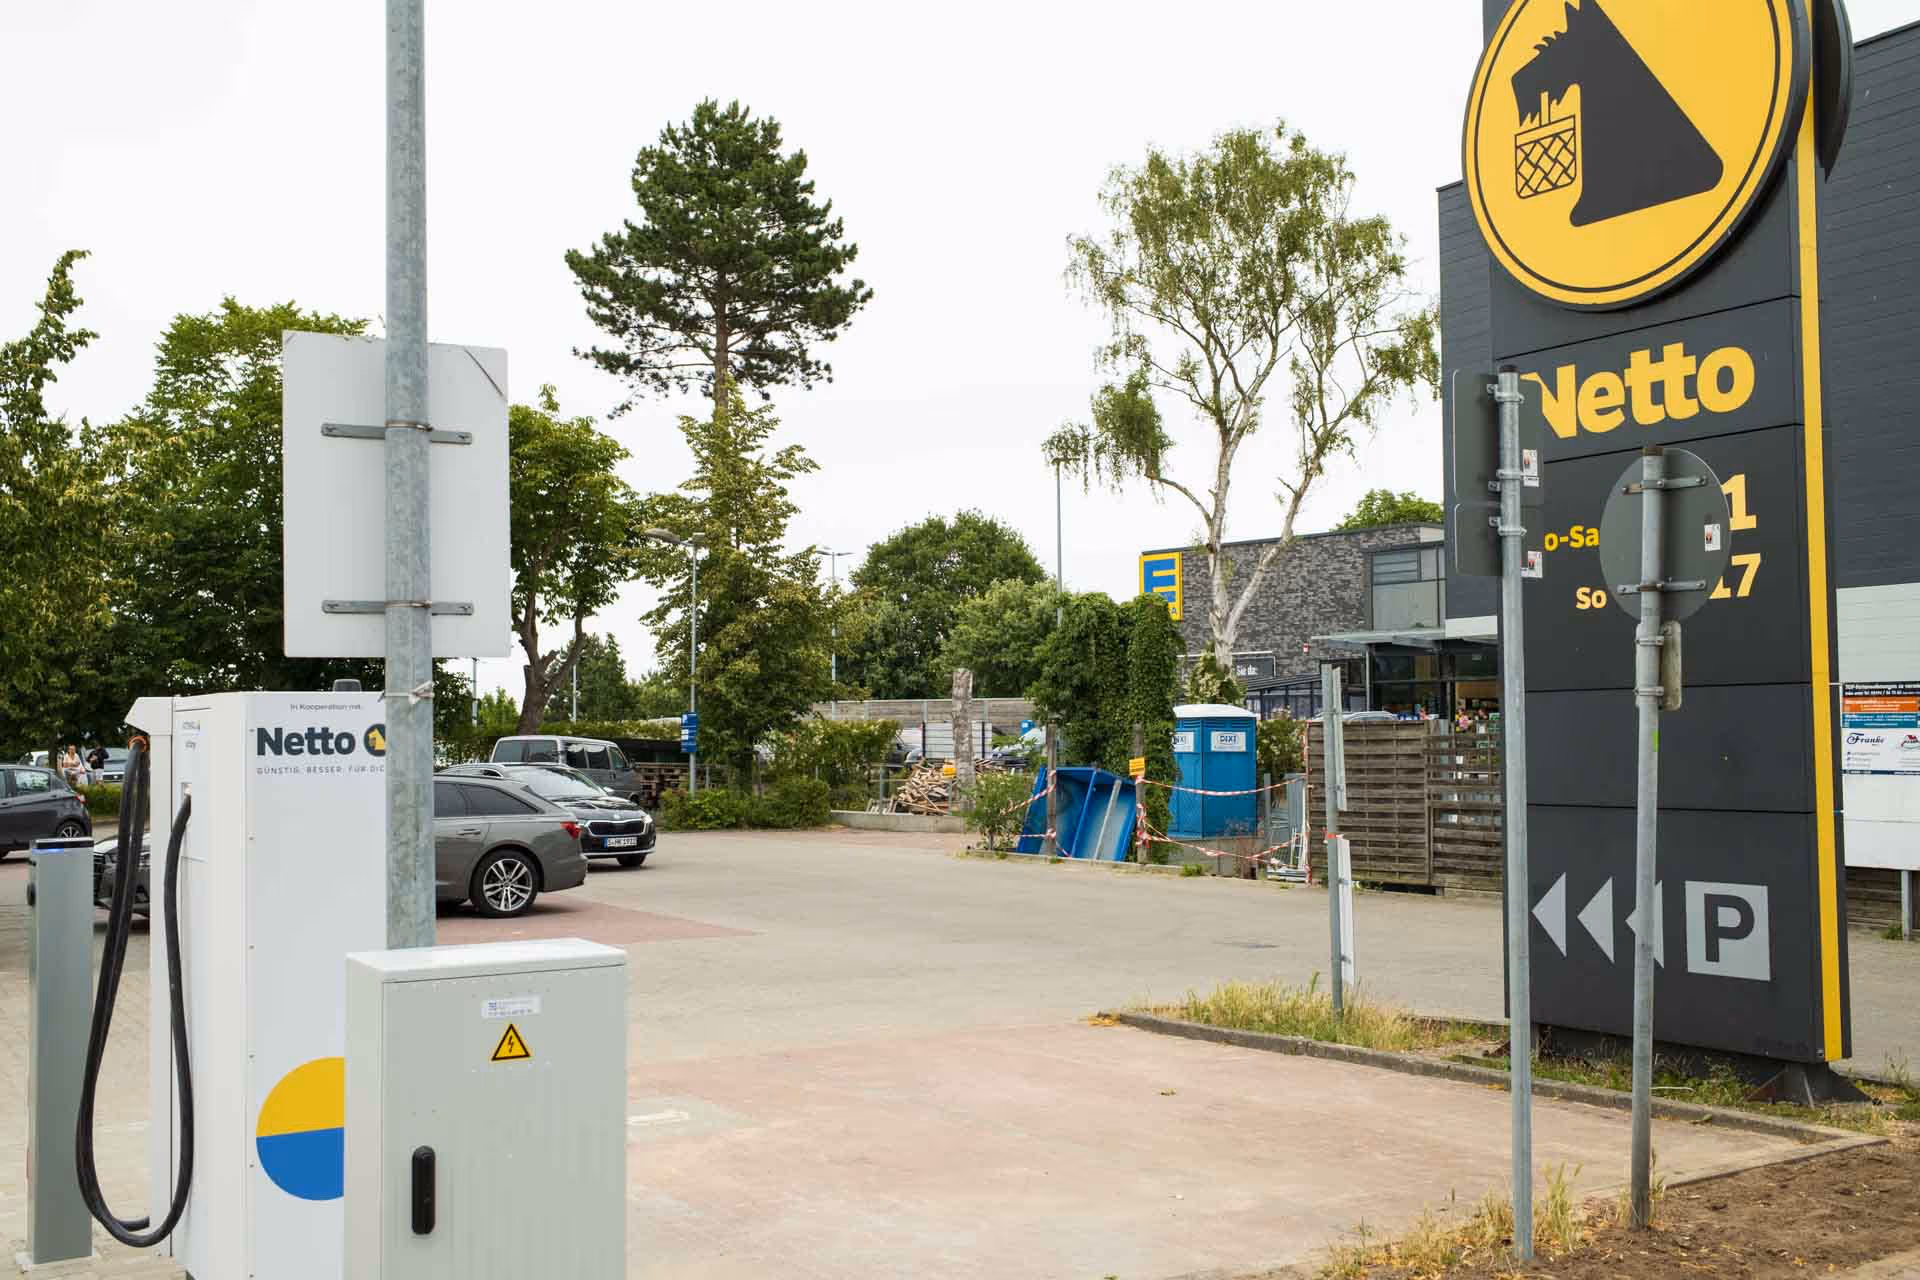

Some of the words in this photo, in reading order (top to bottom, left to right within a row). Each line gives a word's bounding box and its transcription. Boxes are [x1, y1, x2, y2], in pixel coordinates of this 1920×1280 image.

[1520, 341, 1755, 439] Netto
[1722, 473, 1757, 531] 1
[1544, 524, 1600, 552] o-Sa
[1575, 586, 1608, 610] So
[299, 703, 347, 712] Kooperation
[256, 726, 356, 757] Netto
[1219, 735, 1237, 743] DIXI
[1846, 733, 1885, 745] Franke
[370, 765, 385, 773] DIC
[1704, 893, 1755, 963] P
